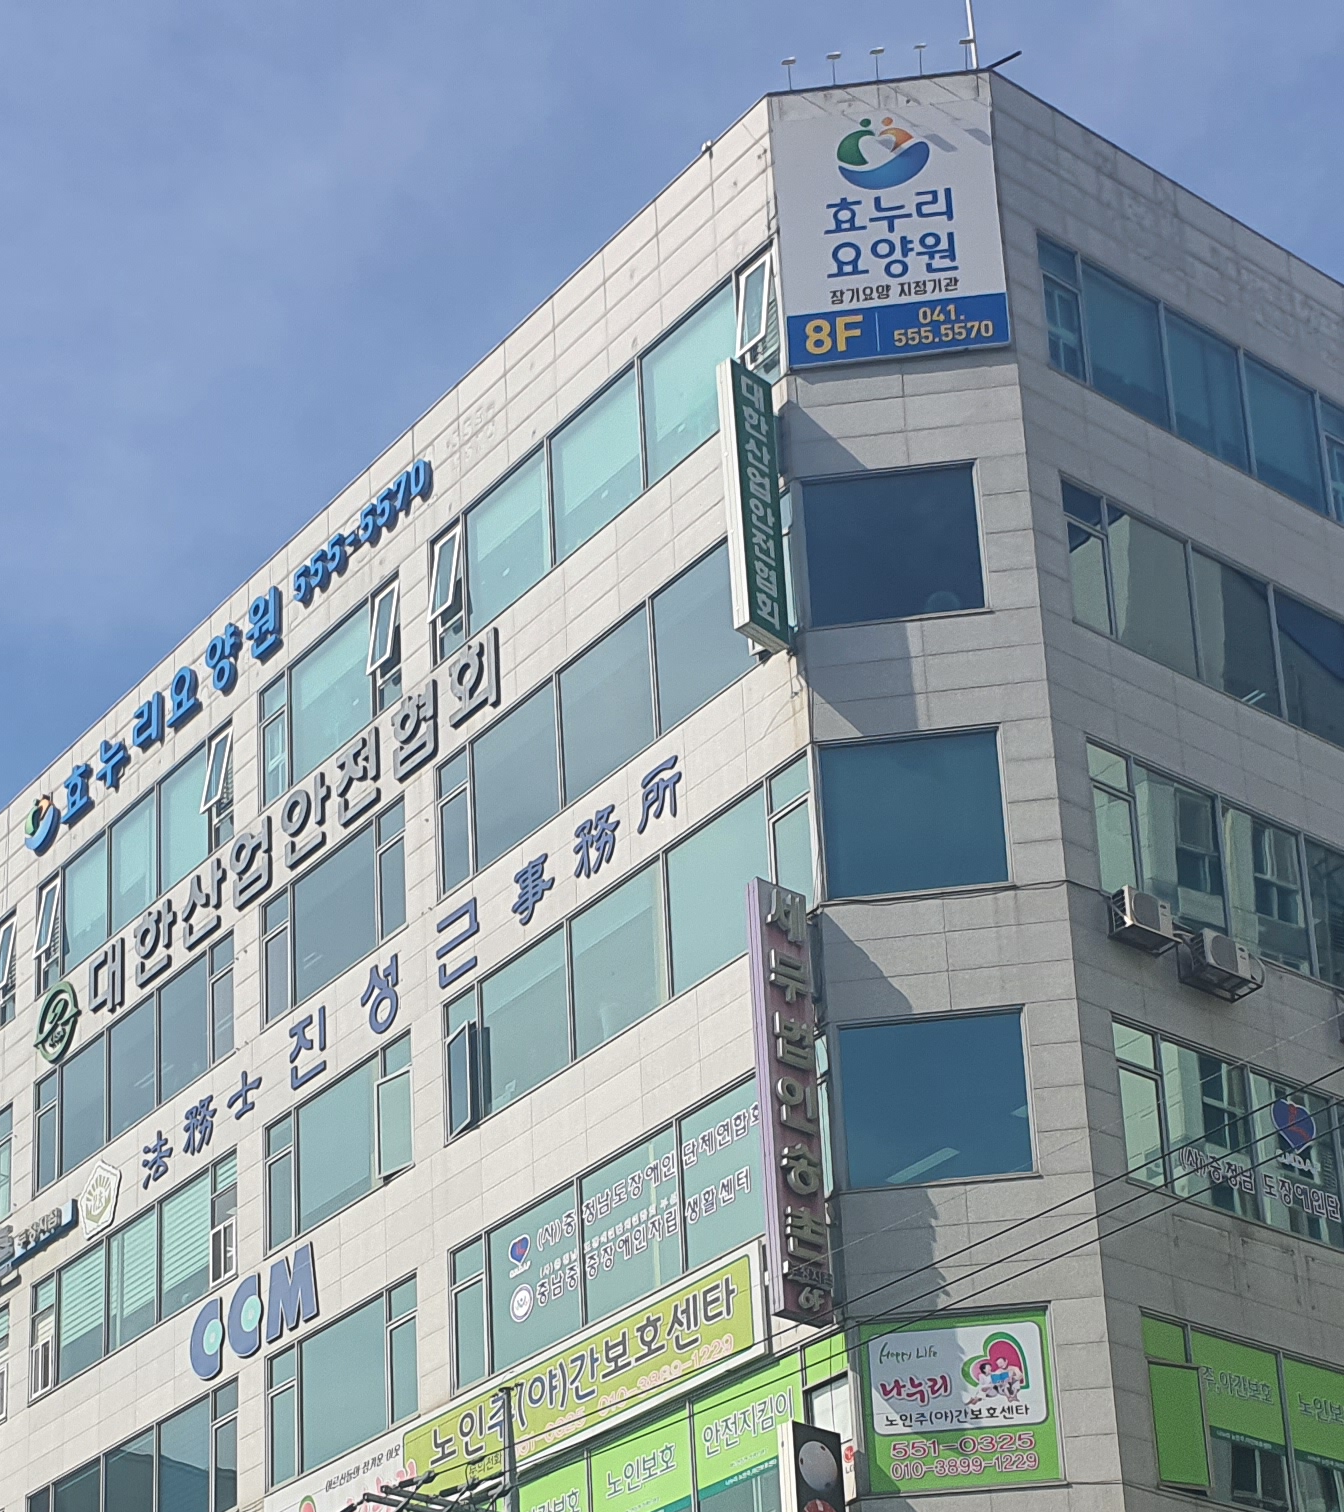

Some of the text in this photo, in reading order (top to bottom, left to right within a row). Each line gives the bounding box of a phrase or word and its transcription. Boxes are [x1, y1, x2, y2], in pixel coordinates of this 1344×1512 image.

[824, 187, 955, 236] 효누리
[827, 232, 960, 281] 요양원
[830, 277, 960, 306] 장기요양 지정기관
[804, 315, 865, 356] 8F
[893, 320, 994, 348] 555.5570
[61, 459, 433, 824] 효누리요양원 555-5570
[88, 626, 502, 1014] 대한산업안전협회
[765, 884, 829, 1262] 세무법인송촌
[189, 1241, 318, 1381] CCM
[879, 1342, 938, 1365] Happy Life
[879, 1375, 952, 1406] 나누리
[702, 1385, 794, 1459] 안전지킴이
[884, 1404, 1031, 1428] 노인주(야)간보호센타
[891, 1432, 1035, 1459] 551-0325
[891, 1452, 1039, 1480] 010-3899-1229
[606, 1441, 676, 1499] 노인보호
